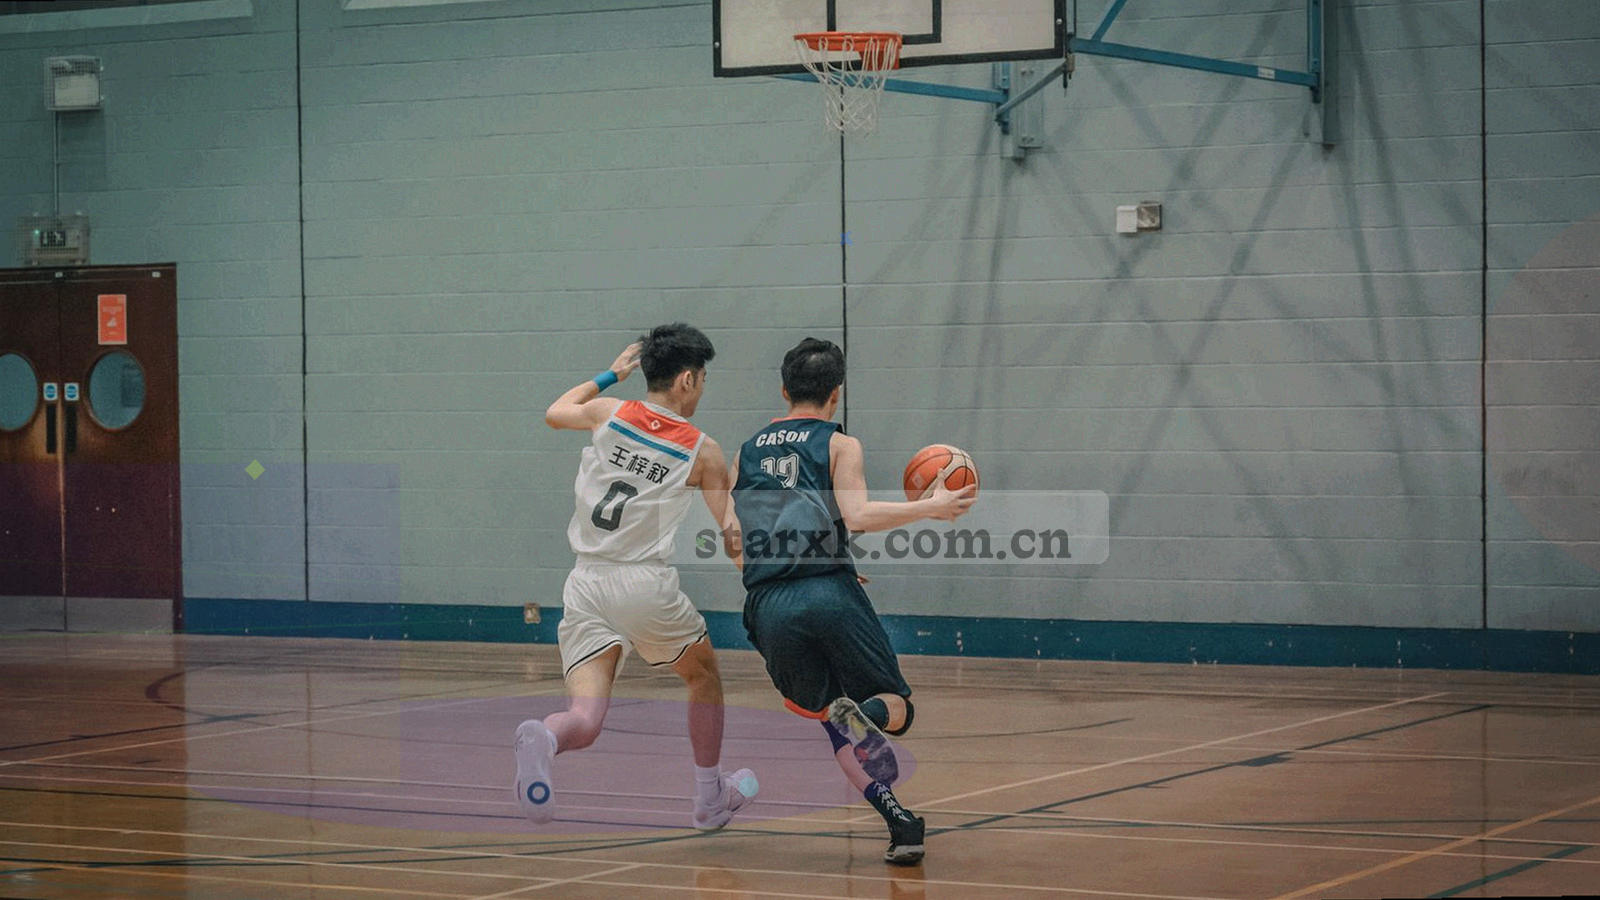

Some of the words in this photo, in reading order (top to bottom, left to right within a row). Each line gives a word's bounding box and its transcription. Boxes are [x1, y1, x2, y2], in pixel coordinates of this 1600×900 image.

[755, 429, 810, 447] CASON
[608, 445, 670, 484] 王梓叙
[591, 479, 638, 532] 0
